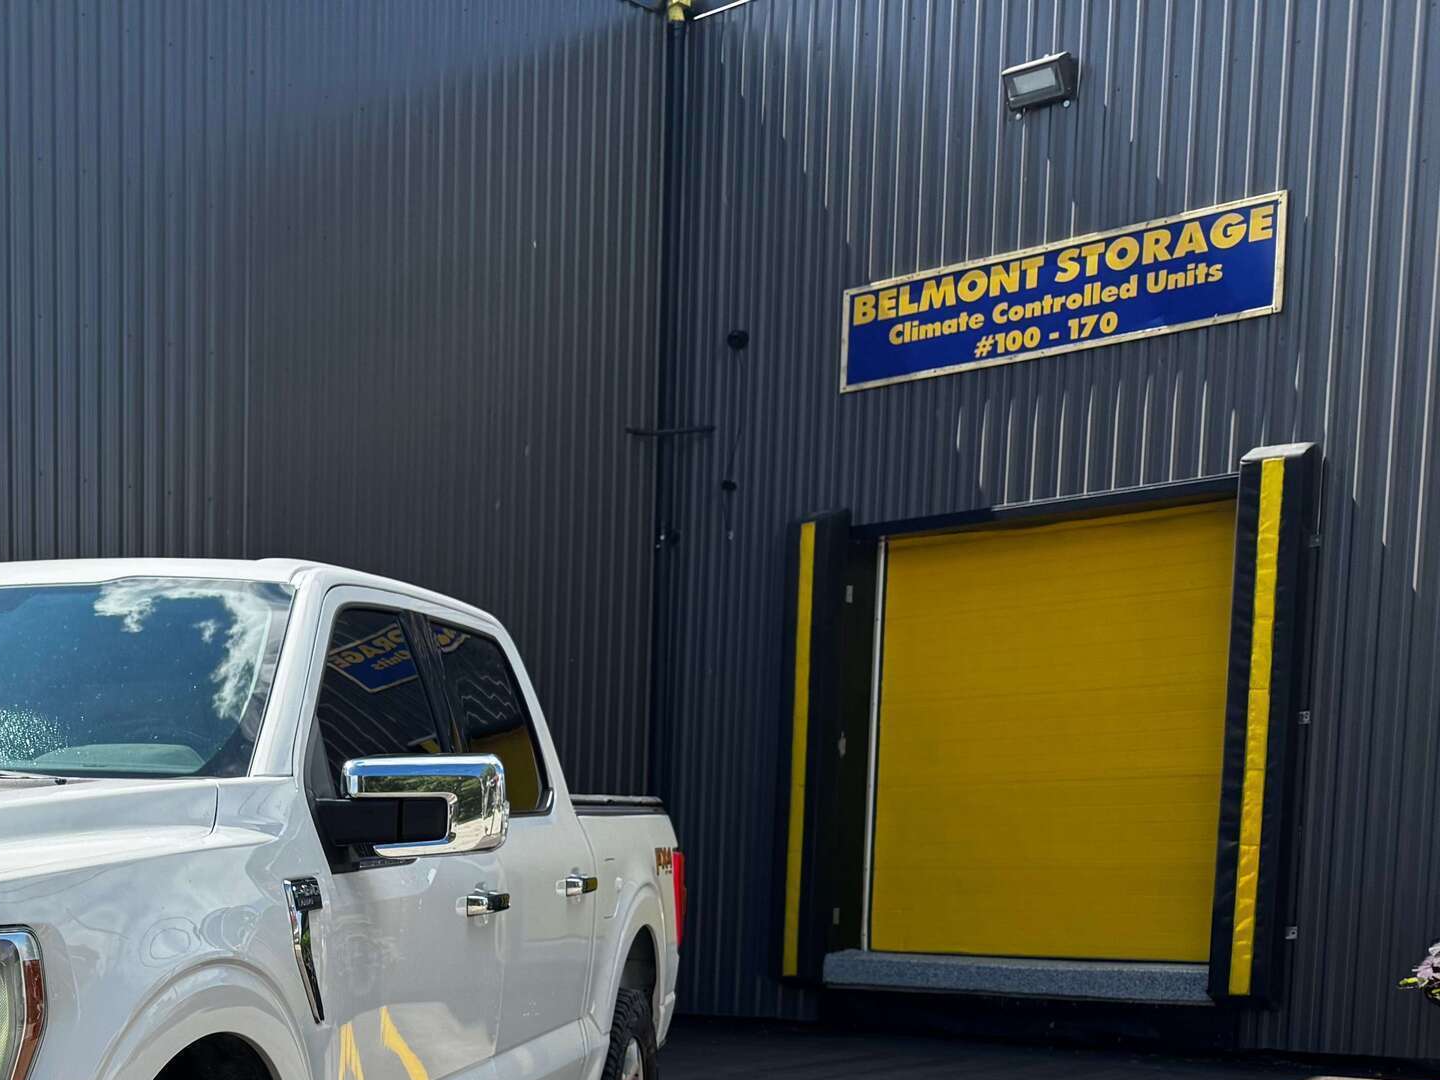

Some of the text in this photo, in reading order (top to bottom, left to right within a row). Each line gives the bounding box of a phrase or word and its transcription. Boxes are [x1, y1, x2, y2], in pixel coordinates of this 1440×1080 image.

[853, 204, 1275, 326] BELMONT STORAGE
[888, 262, 1223, 346] Climate Controlled Units
[974, 325, 1041, 357] #100
[1068, 311, 1119, 340] 170
